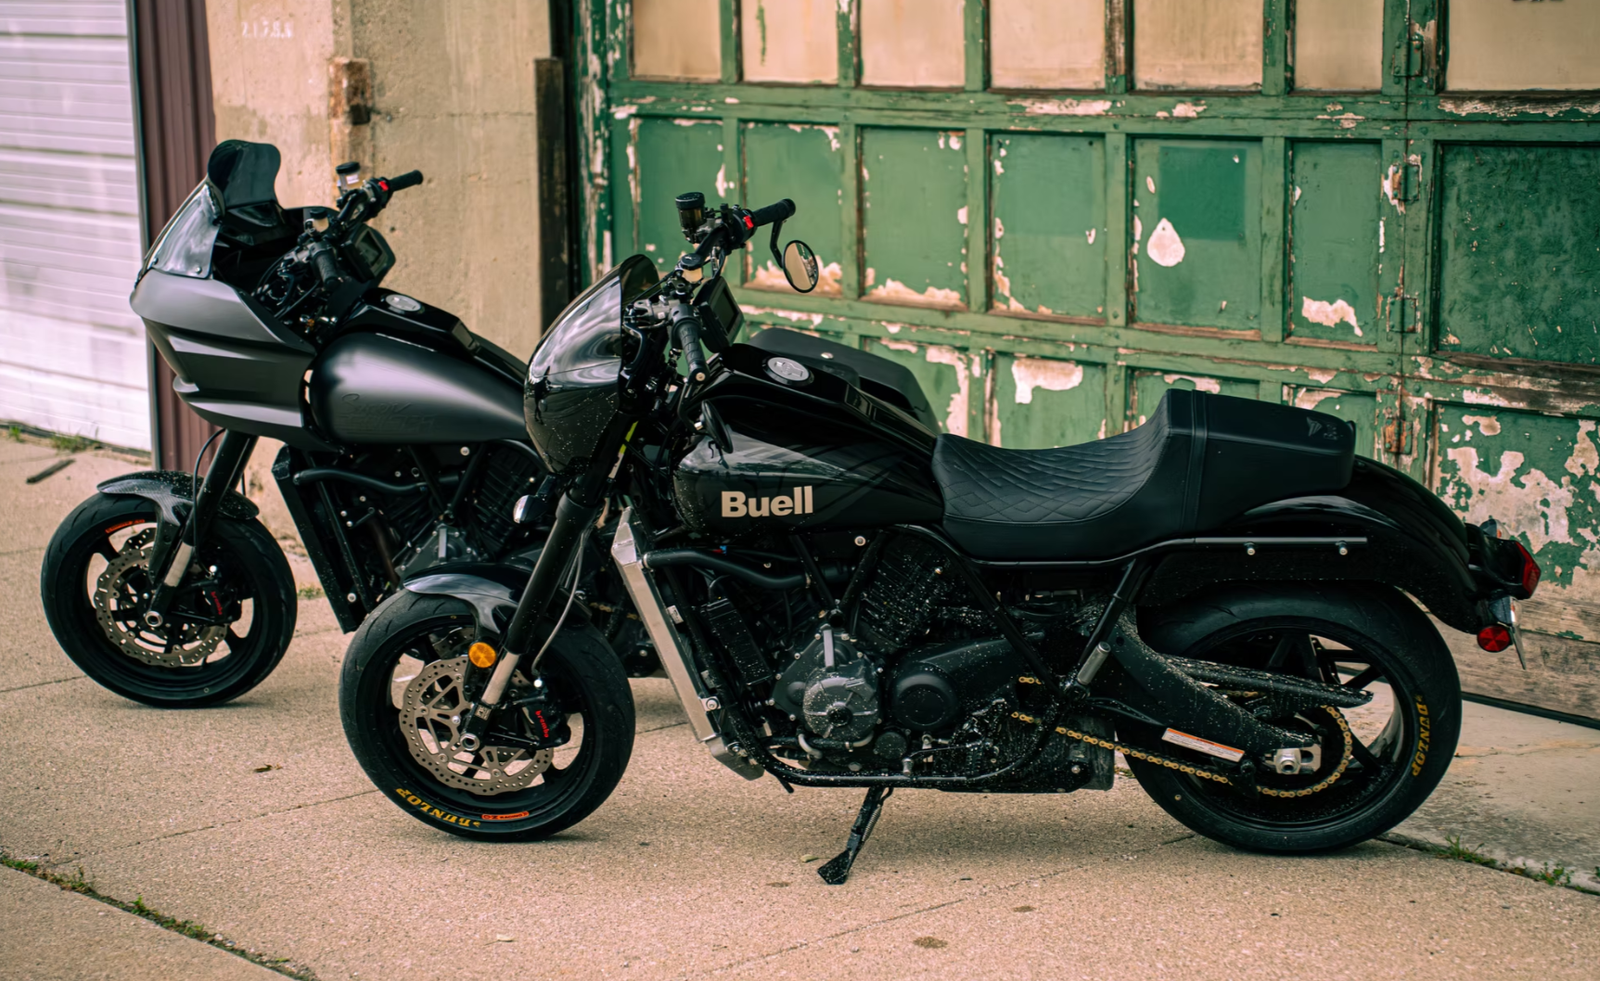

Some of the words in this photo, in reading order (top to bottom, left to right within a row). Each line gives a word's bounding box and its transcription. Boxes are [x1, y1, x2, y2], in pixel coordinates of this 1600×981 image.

[721, 485, 813, 518] Buell
[535, 710, 549, 738] brembo
[1411, 702, 1430, 776] DUNLOP
[395, 788, 470, 827] DUNLOP
